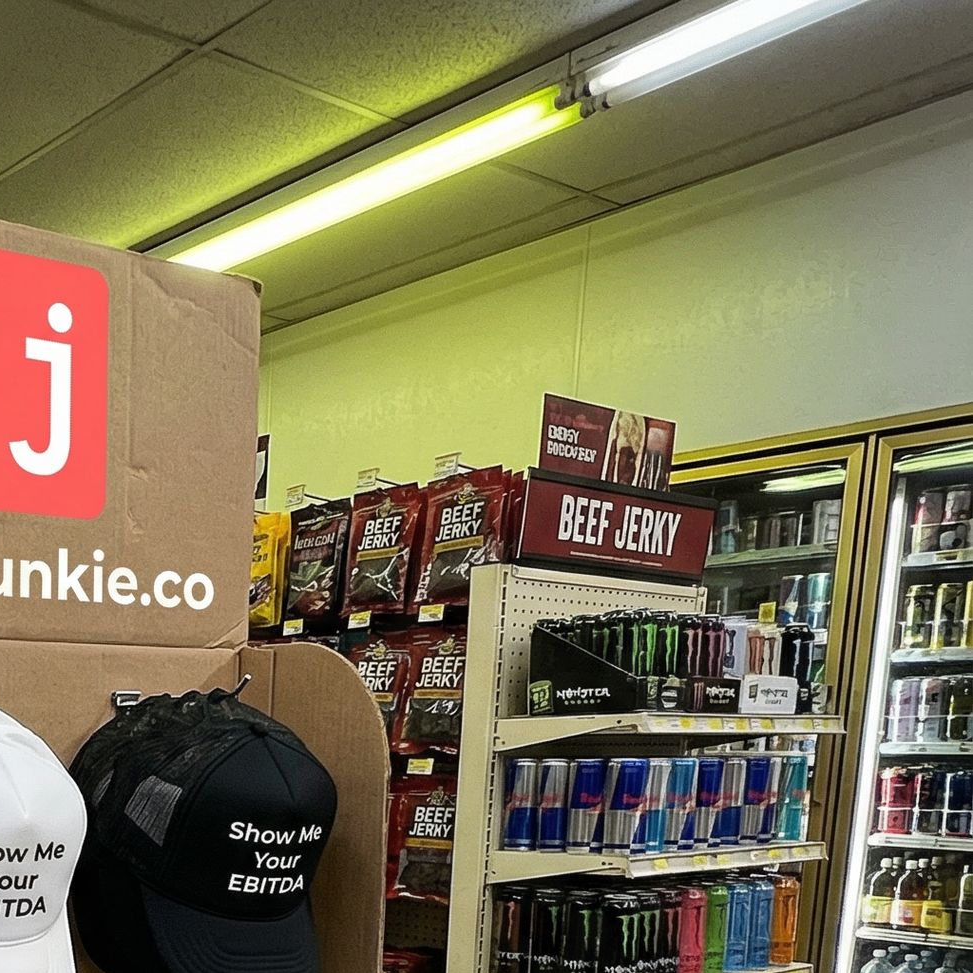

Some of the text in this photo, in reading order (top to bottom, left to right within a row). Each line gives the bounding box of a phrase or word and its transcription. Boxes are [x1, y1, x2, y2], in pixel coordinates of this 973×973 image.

[441, 501, 485, 525] BEEF
[364, 516, 403, 535] BEEF
[435, 519, 483, 542] JERKY
[557, 494, 682, 556] BEEF JERKY
[357, 532, 400, 550] JERKY
[421, 657, 466, 673] BEEF
[415, 673, 463, 688] JERKY
[414, 806, 455, 823] BEEF
[229, 821, 322, 844] Show Me
[408, 823, 453, 838] JERKY
[34, 841, 65, 861] Me
[254, 851, 302, 870] Your
[228, 873, 304, 894] EBITDA
